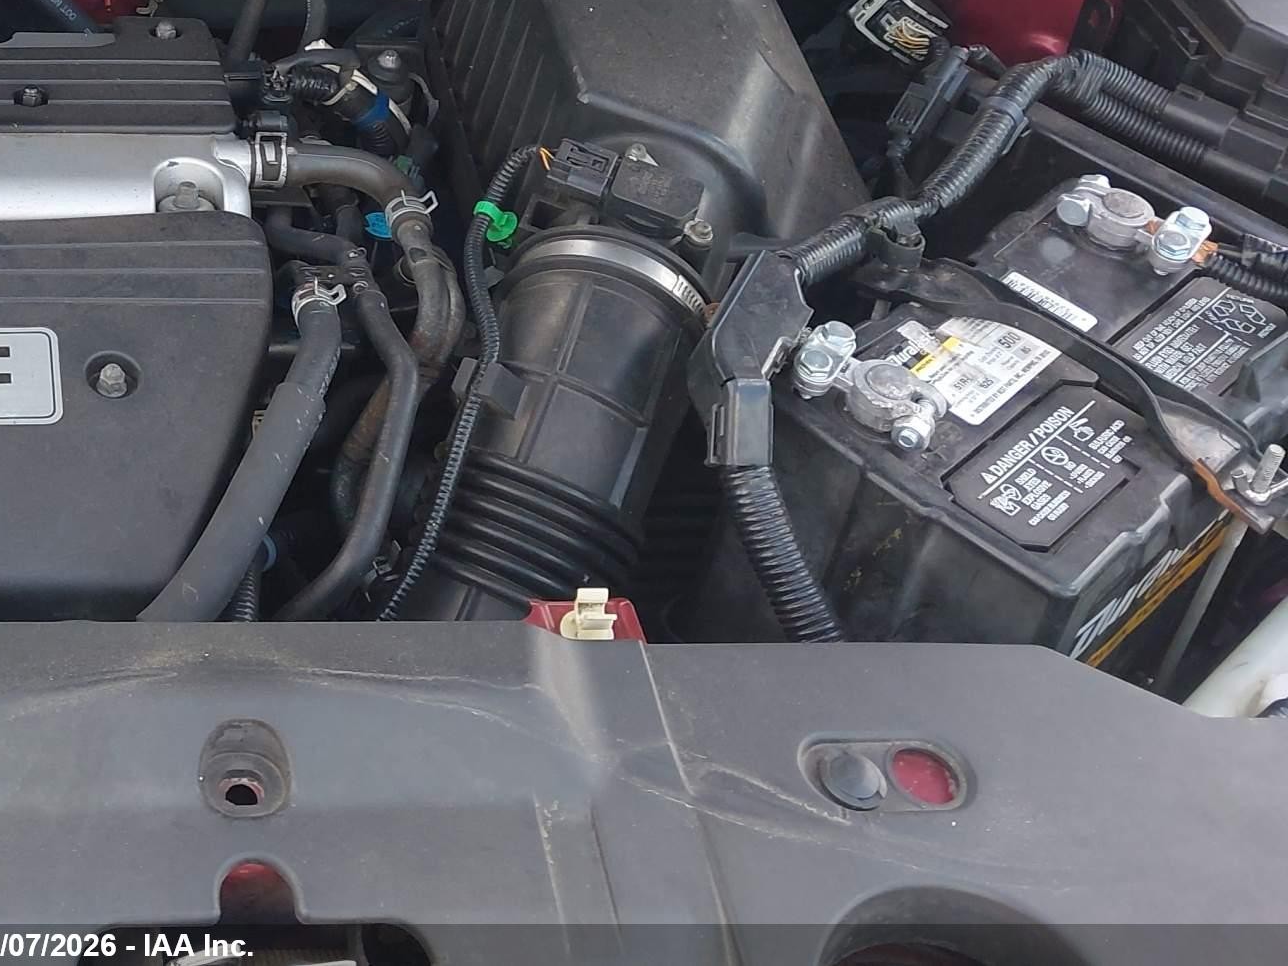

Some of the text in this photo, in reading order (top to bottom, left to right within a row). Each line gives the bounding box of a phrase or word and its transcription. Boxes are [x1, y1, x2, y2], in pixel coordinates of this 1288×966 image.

[997, 332, 1022, 350] 500
[986, 437, 1036, 477] DANGER
[1031, 404, 1076, 439] POISON
[1013, 466, 1038, 486] SHIELD
[1019, 478, 1054, 506] EXPLOSIVE
